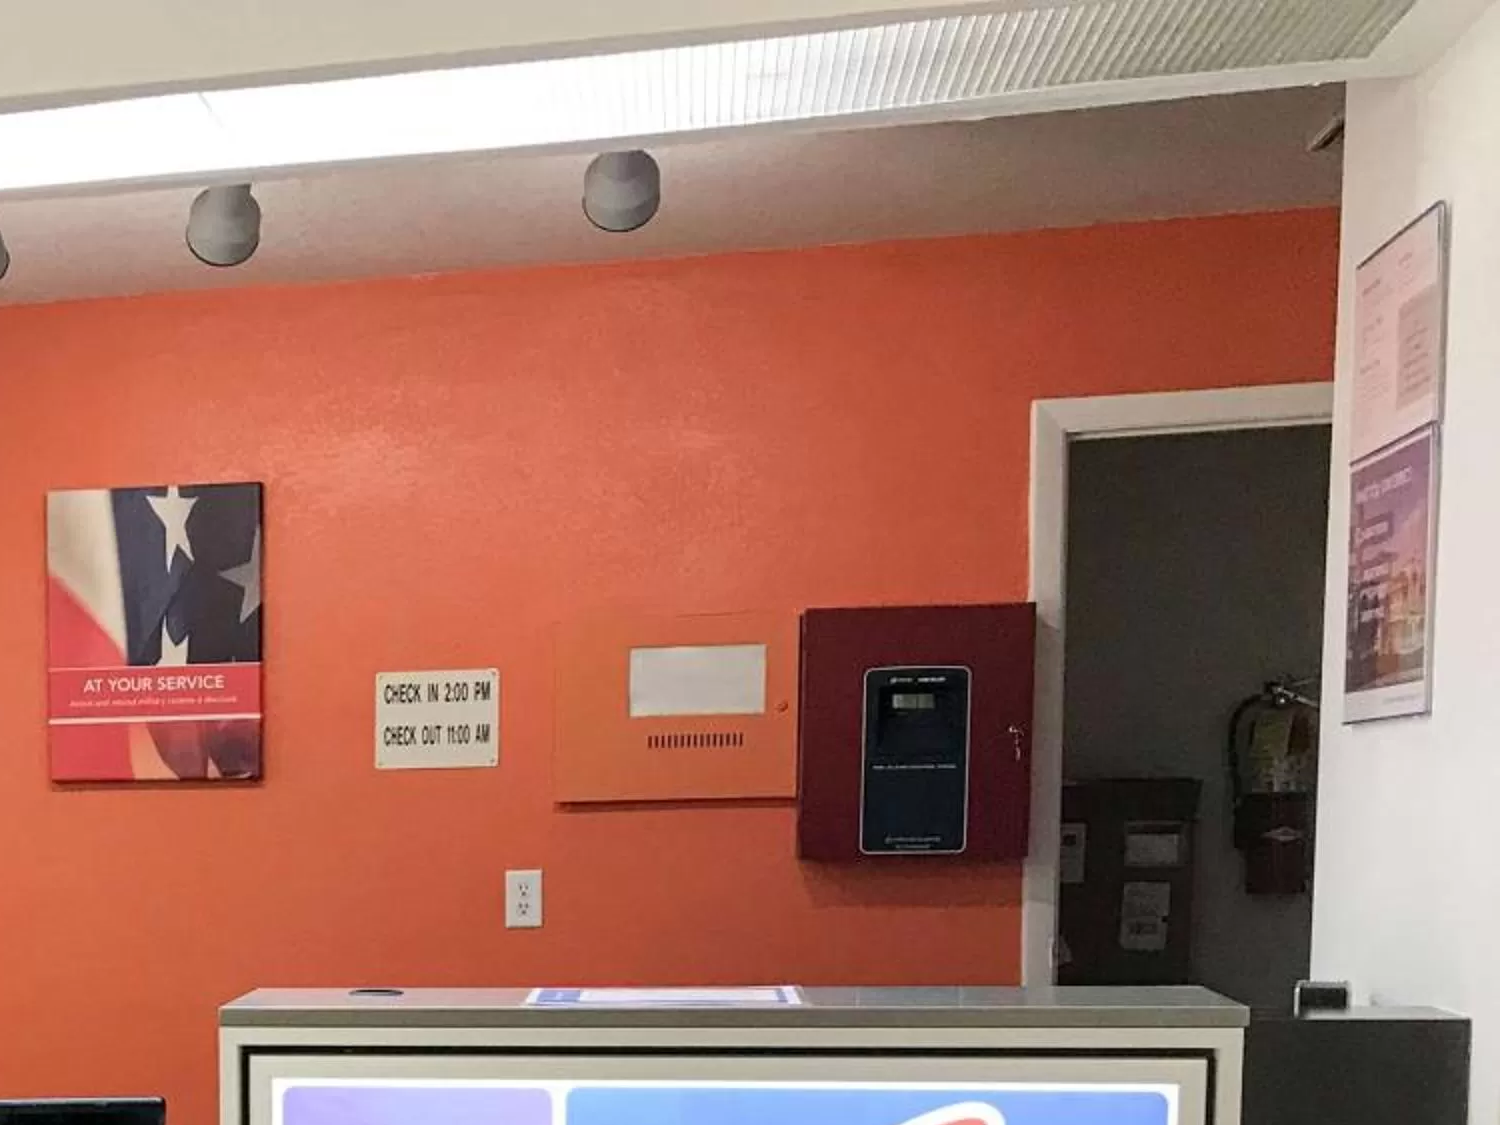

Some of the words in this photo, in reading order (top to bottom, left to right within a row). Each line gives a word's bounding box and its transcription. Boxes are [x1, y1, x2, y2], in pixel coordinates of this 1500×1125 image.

[83, 679, 102, 693] AT
[107, 677, 151, 692] YOUR
[157, 675, 226, 690] SERVICE
[384, 682, 421, 704] CHECK
[427, 683, 439, 702] IN
[445, 682, 469, 703] 2:00
[474, 680, 491, 701] PM
[384, 725, 417, 747] CHECK
[421, 724, 442, 745] OUT
[475, 723, 491, 744] AM
